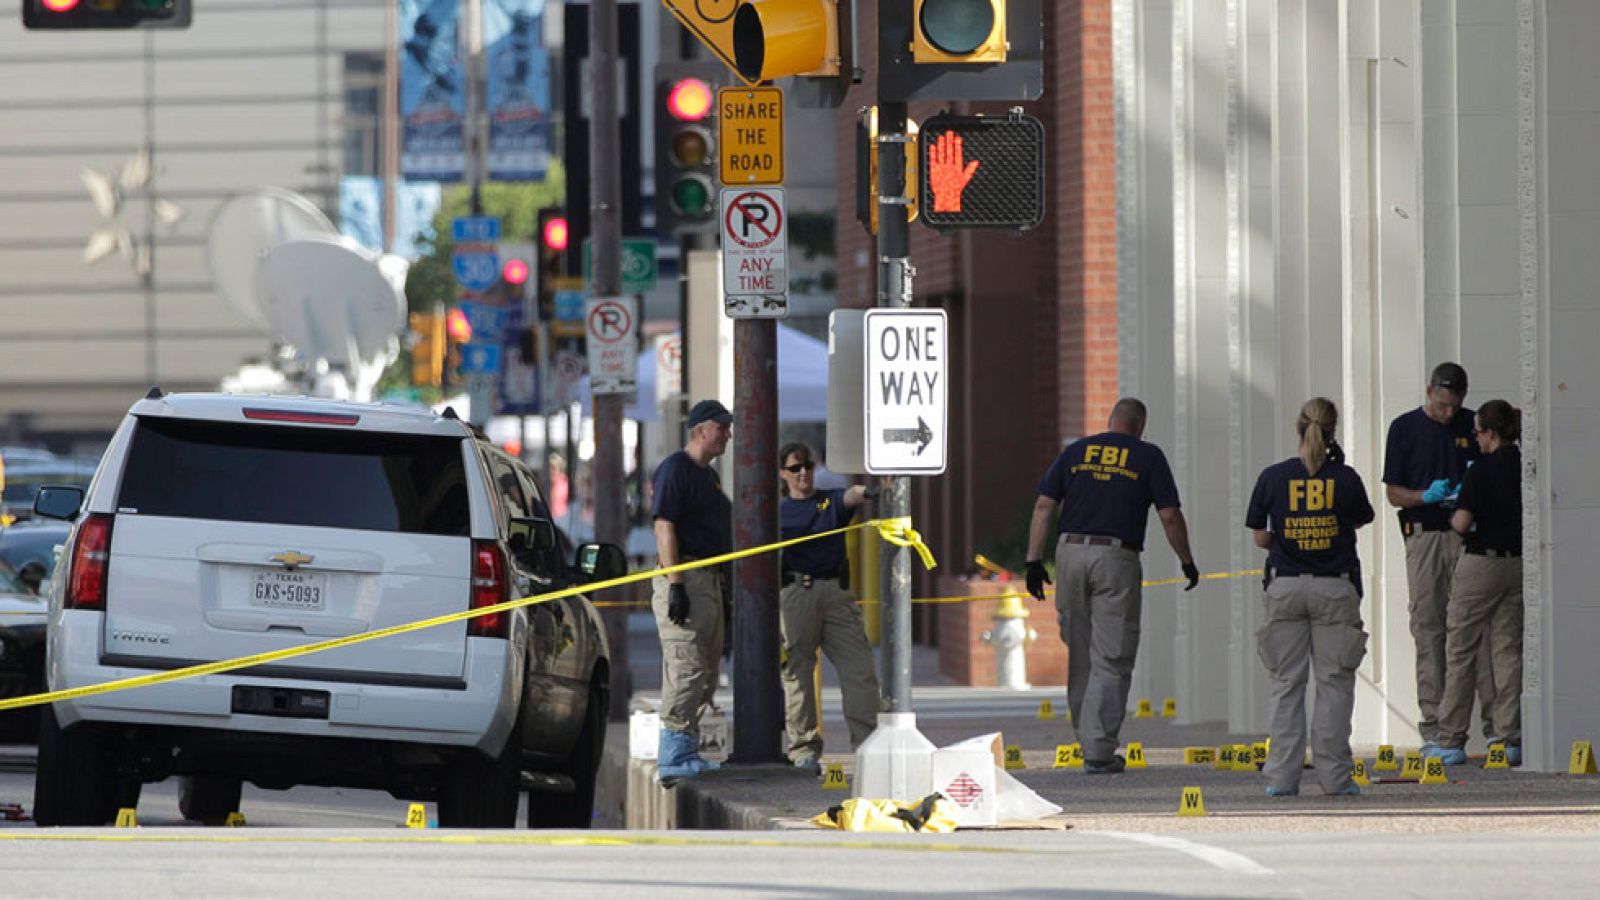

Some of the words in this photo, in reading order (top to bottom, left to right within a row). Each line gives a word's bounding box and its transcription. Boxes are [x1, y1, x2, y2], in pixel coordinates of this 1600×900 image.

[724, 102, 777, 119] SHARE
[736, 128, 767, 145] THE
[730, 154, 773, 171] ROAD
[740, 257, 774, 272] ANY
[738, 273, 775, 290] TIME
[880, 326, 937, 362] ONE
[601, 350, 625, 360] ANY
[880, 371, 938, 406] WAY
[1084, 444, 1129, 468] FBI
[1289, 479, 1335, 512] FBI
[1285, 515, 1337, 528] EVIDENC
[1296, 538, 1331, 550] TEAM
[276, 573, 304, 583] TEXAS
[1129, 748, 1142, 761] 41
[1379, 750, 1394, 762] 49
[1490, 750, 1505, 763] 59
[1407, 757, 1421, 770] 72
[829, 769, 843, 783] 70
[1184, 792, 1199, 808] W
[410, 809, 422, 824] 23
